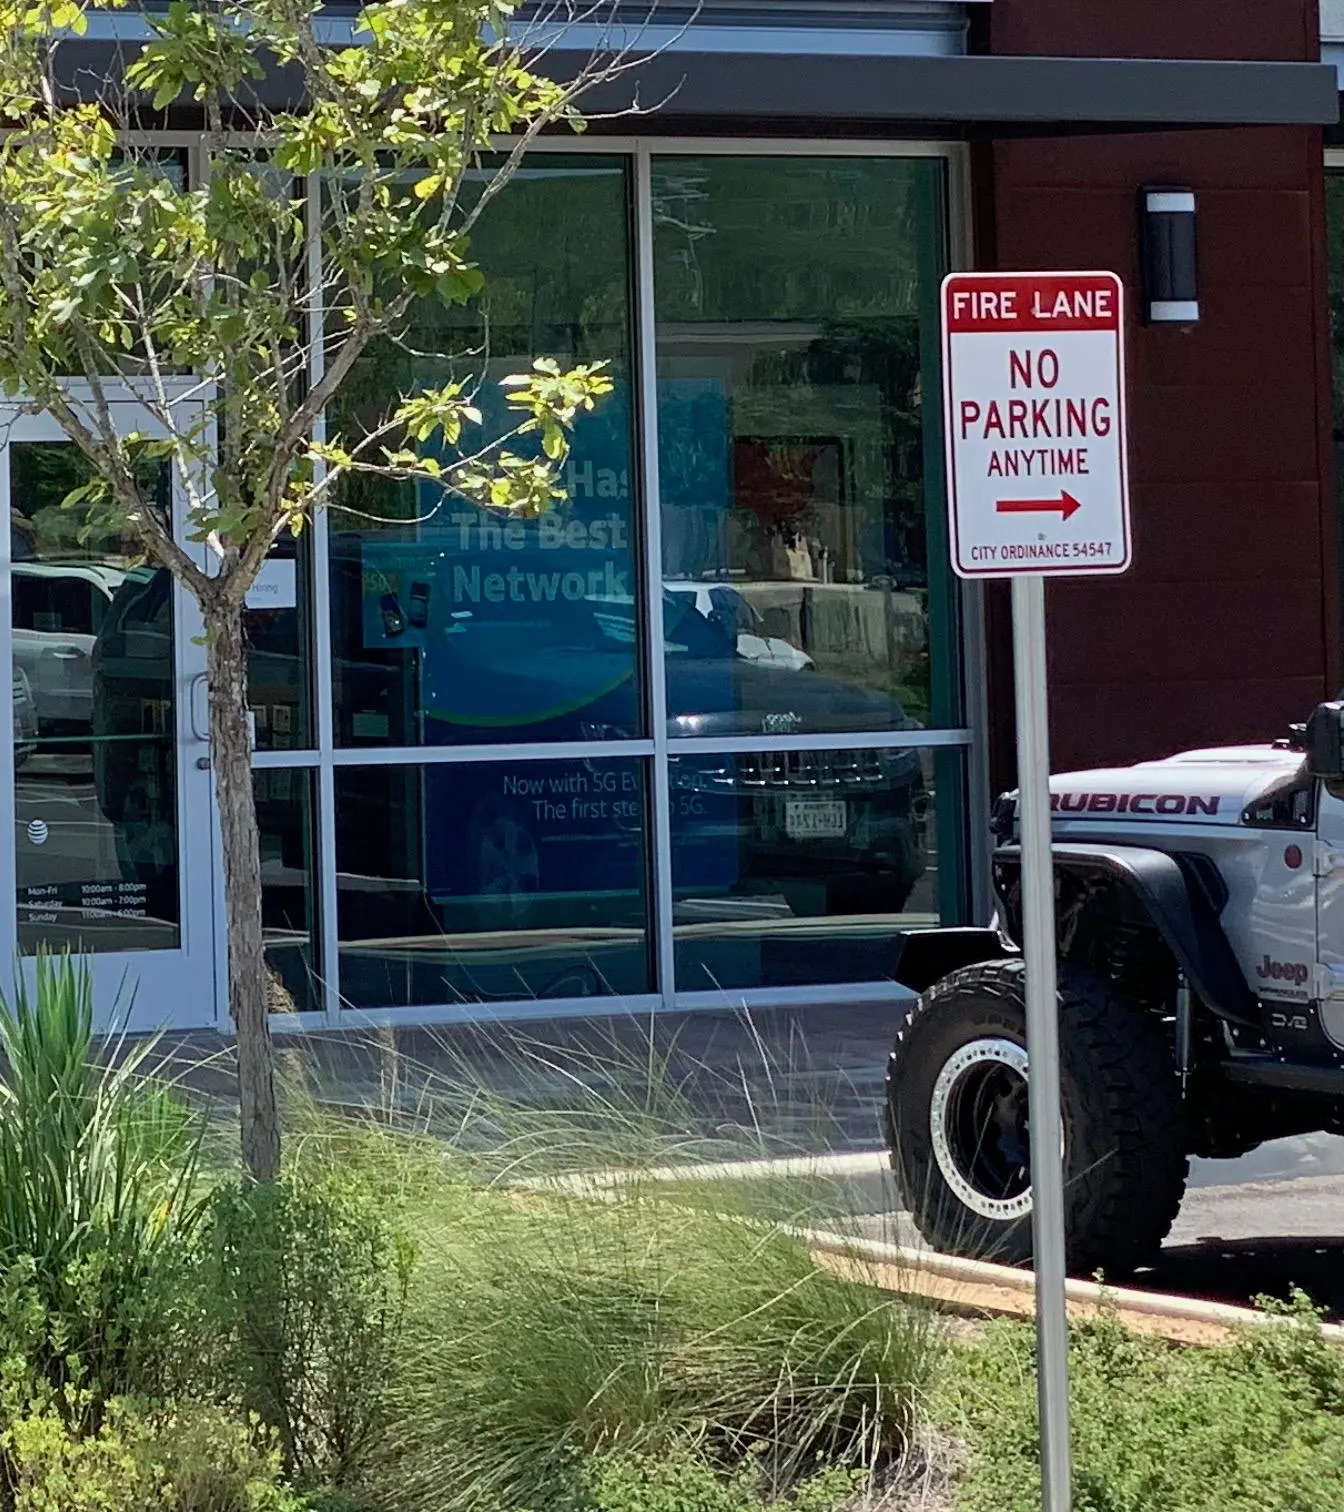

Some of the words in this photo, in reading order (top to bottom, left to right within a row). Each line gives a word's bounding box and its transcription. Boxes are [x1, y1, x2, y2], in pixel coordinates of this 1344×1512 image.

[953, 291, 1017, 320] FIRE
[1034, 290, 1112, 318] LANE
[1009, 349, 1059, 389] NO
[960, 398, 1111, 439] PARKING
[987, 448, 1089, 477] ANYTIME
[451, 512, 525, 551] The
[539, 511, 628, 551] Best
[971, 546, 997, 561] CITY
[1001, 543, 1070, 560] ORDINANCE
[1072, 541, 1112, 558] 54547
[453, 560, 630, 604] Network
[503, 776, 544, 795] Now
[549, 772, 587, 793] with
[593, 771, 616, 792] 5G
[532, 800, 566, 821] The
[572, 797, 607, 818] first
[612, 799, 640, 817] ste
[1255, 954, 1308, 986] Jeep
